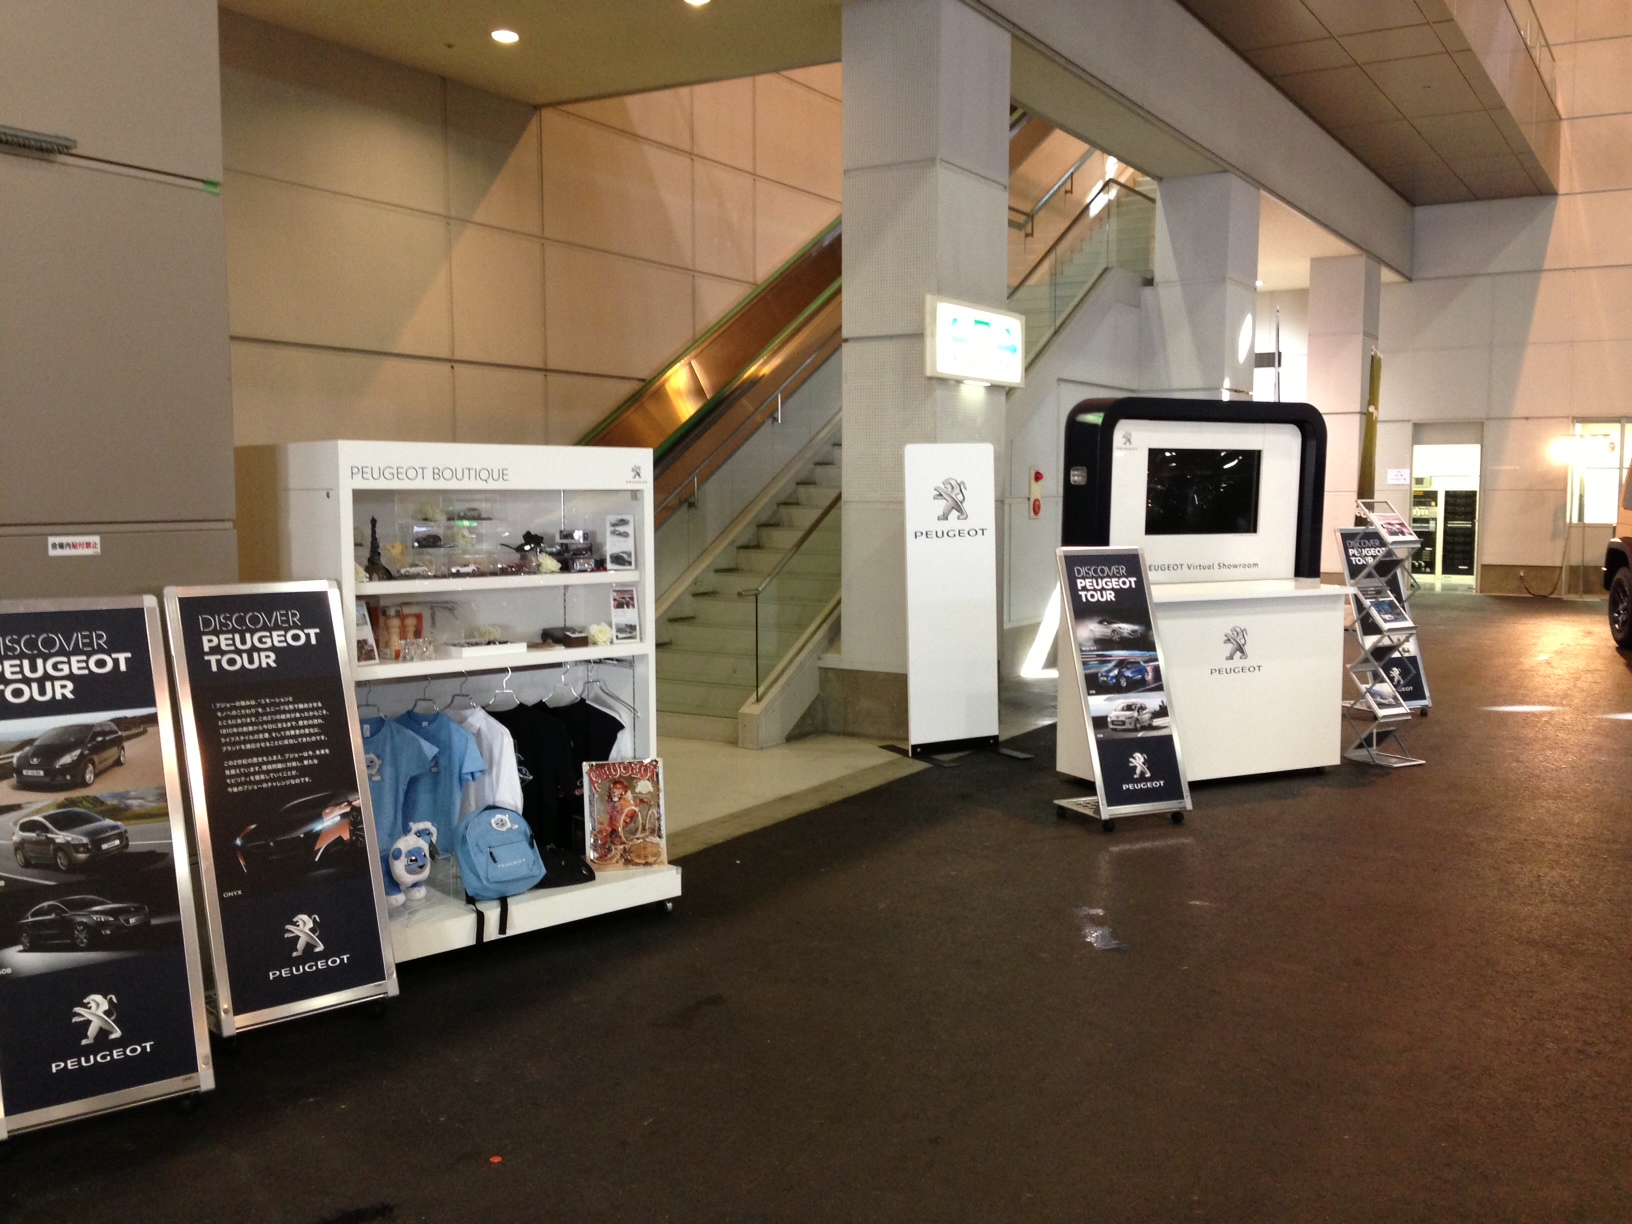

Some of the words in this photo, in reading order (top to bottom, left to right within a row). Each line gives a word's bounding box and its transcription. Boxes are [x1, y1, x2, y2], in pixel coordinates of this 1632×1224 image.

[350, 465, 428, 481] PEUGEOT
[432, 466, 509, 484] BOUTIQUE
[914, 528, 988, 540] PEUGEOT
[1074, 565, 1127, 577] DISCOVER
[1148, 563, 1184, 572] EUGEOT
[1187, 562, 1214, 571] Virtual
[1217, 561, 1259, 570] Showroom
[1076, 577, 1137, 590] PEUGEOT
[1079, 590, 1116, 602] TOUR
[199, 609, 302, 632] DISCOVER
[0, 630, 109, 656] ISCOVER
[201, 628, 320, 653] PEUGEOT
[0, 652, 132, 680] EUGEOT
[204, 651, 277, 673] TOUR
[1210, 665, 1263, 675] PEUGEOT
[587, 760, 659, 793] PEUGEOT
[1122, 780, 1165, 790] PEUGEOT
[223, 889, 242, 898] ONYX
[269, 954, 350, 980] PEUGEOT
[51, 1041, 155, 1073] PEUGEOT
